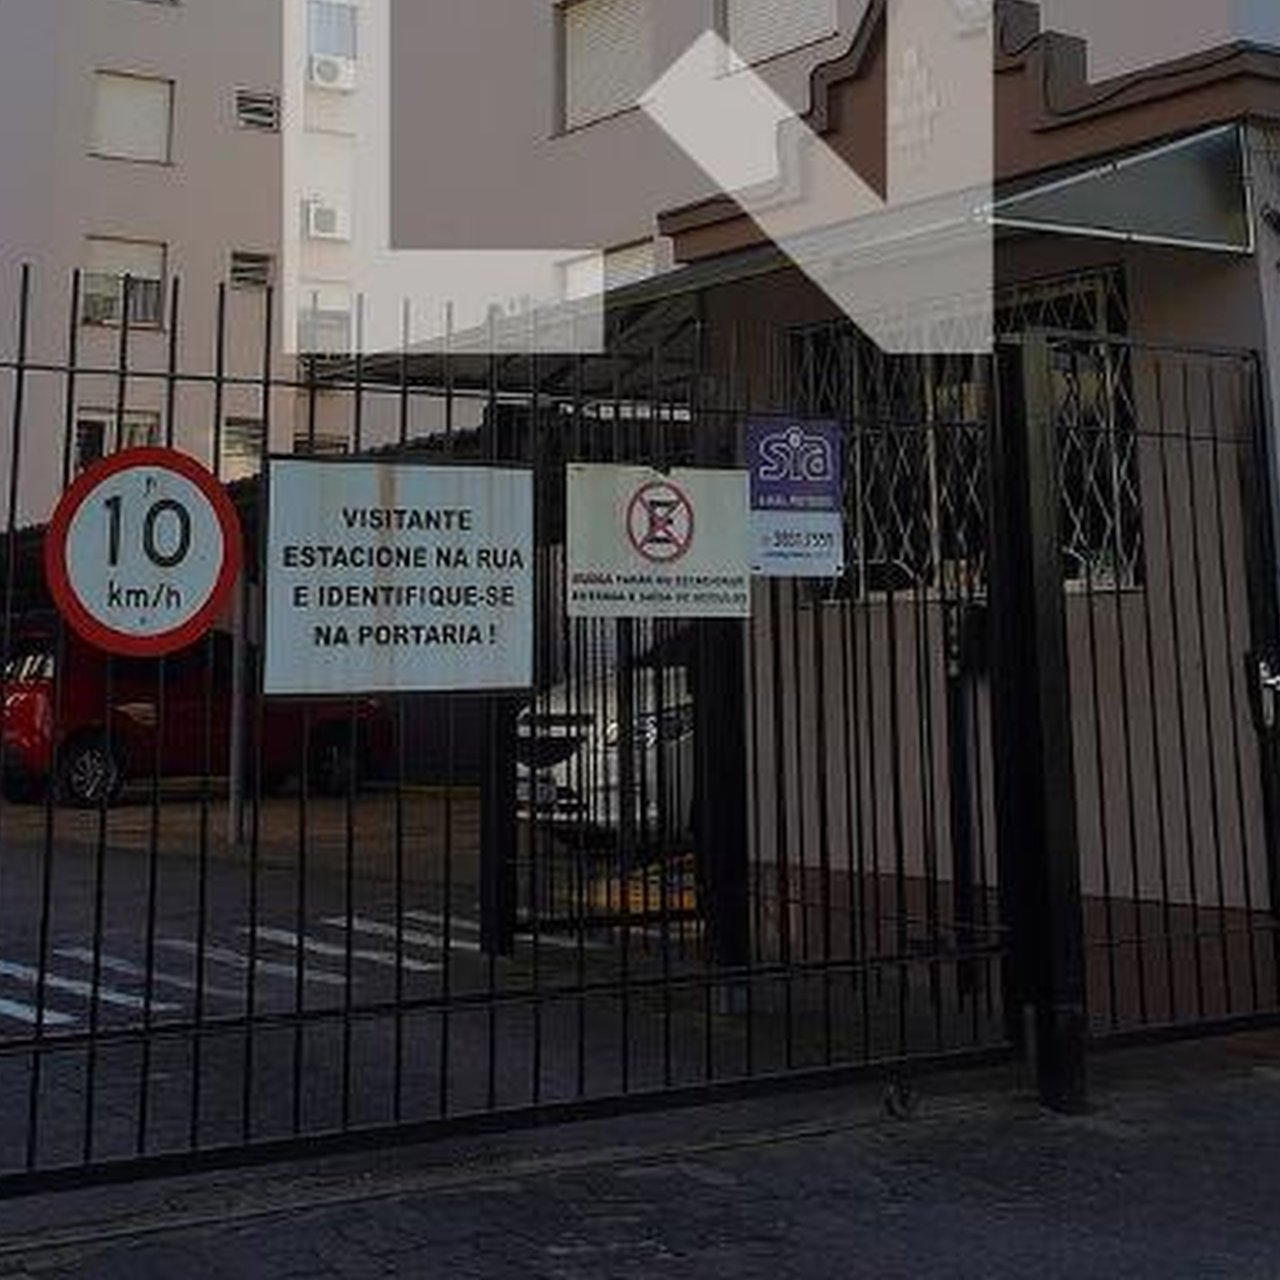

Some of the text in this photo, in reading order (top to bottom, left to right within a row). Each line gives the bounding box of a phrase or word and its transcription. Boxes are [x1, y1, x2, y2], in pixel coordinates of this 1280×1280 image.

[342, 508, 473, 531] VISITANTE
[105, 495, 191, 568] 10
[282, 546, 525, 569] ESTACIONE NA RUA
[107, 579, 182, 609] km/h
[293, 585, 515, 609] E IDENTIFIQUE-SE
[315, 625, 351, 646] NA
